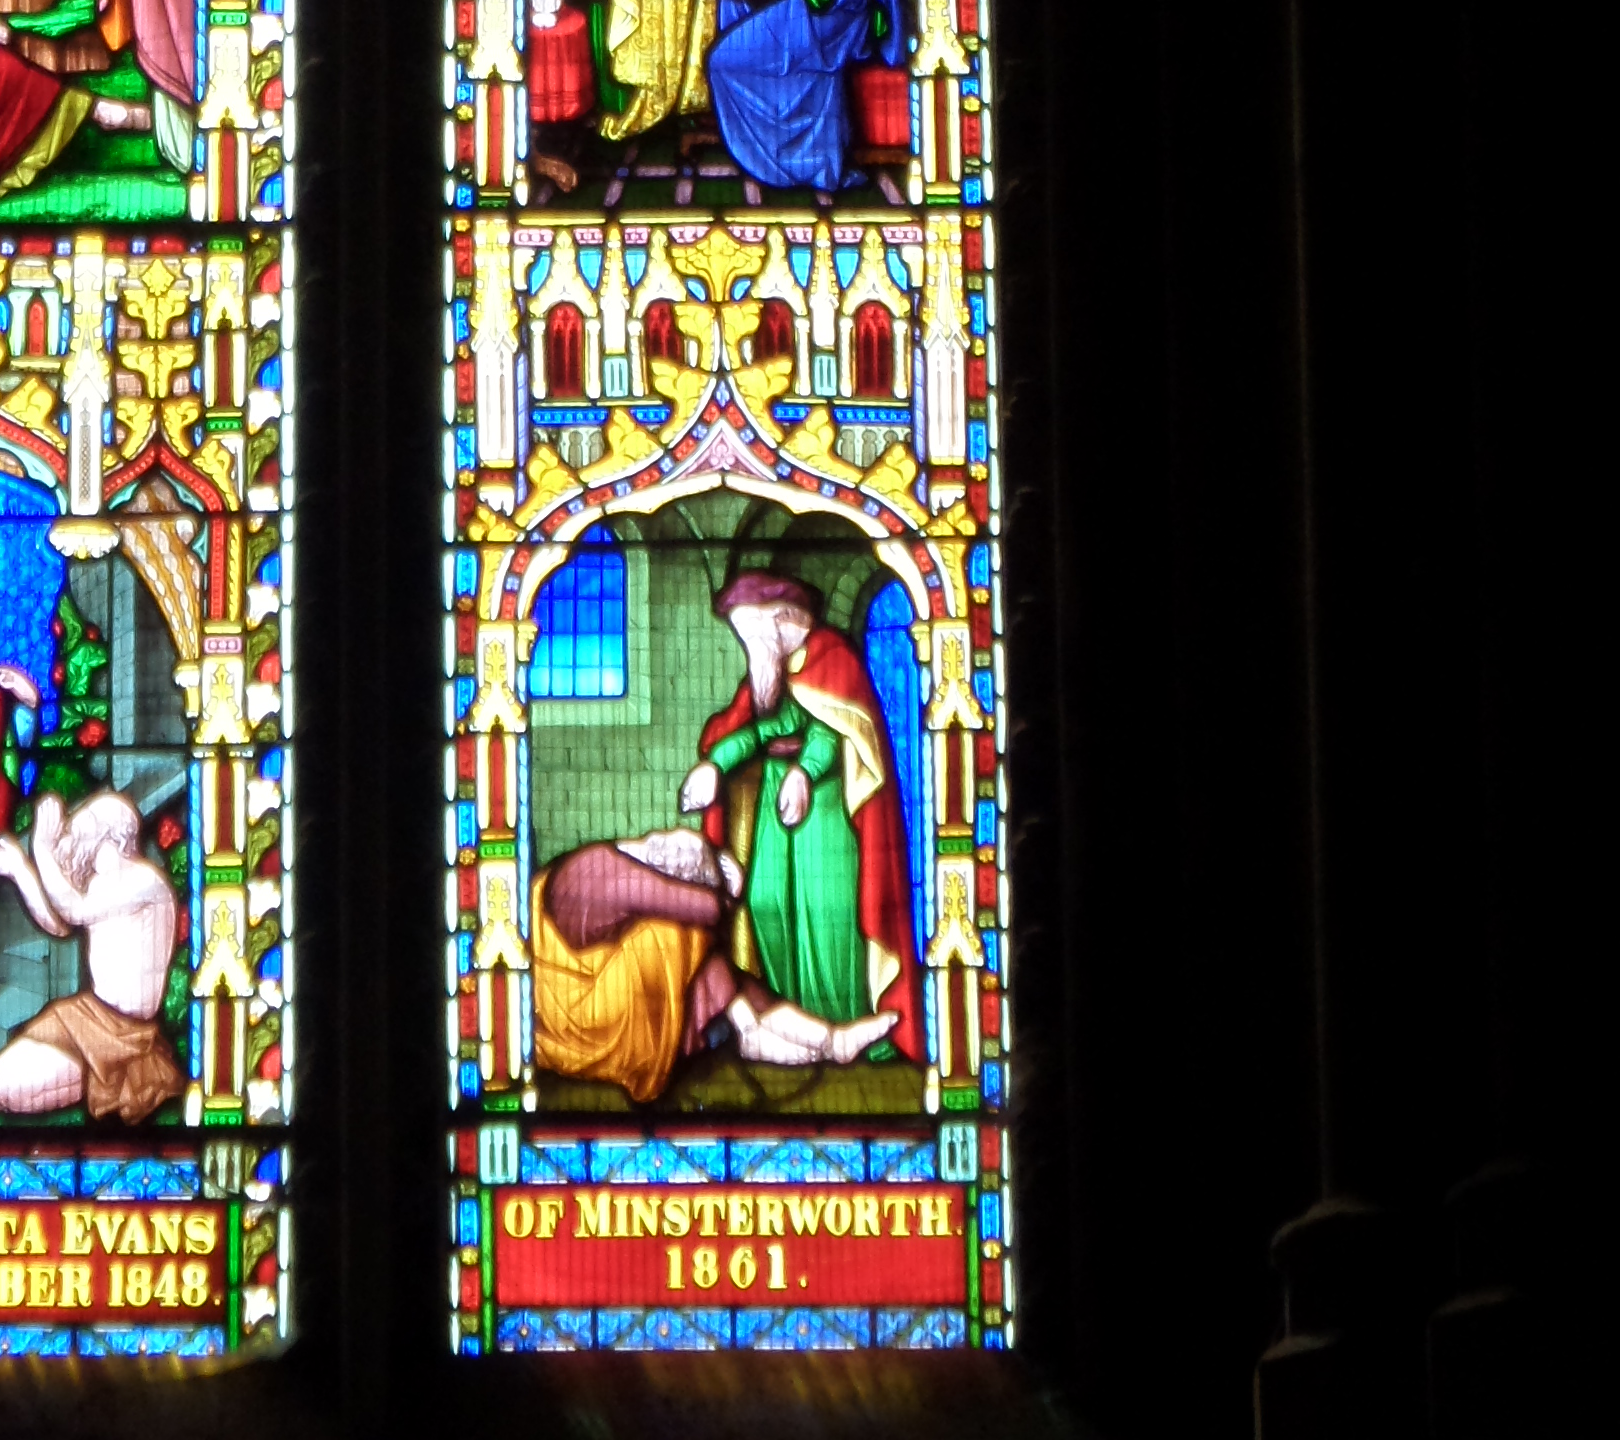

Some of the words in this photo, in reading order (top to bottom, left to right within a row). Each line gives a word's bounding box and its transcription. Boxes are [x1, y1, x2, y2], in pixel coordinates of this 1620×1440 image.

[60, 1204, 218, 1256] EVANS
[502, 1193, 564, 1239] OF
[573, 1189, 964, 1239] MINSTERWORTH.
[107, 1260, 223, 1308] 1848.
[666, 1242, 810, 1290] 1861.
